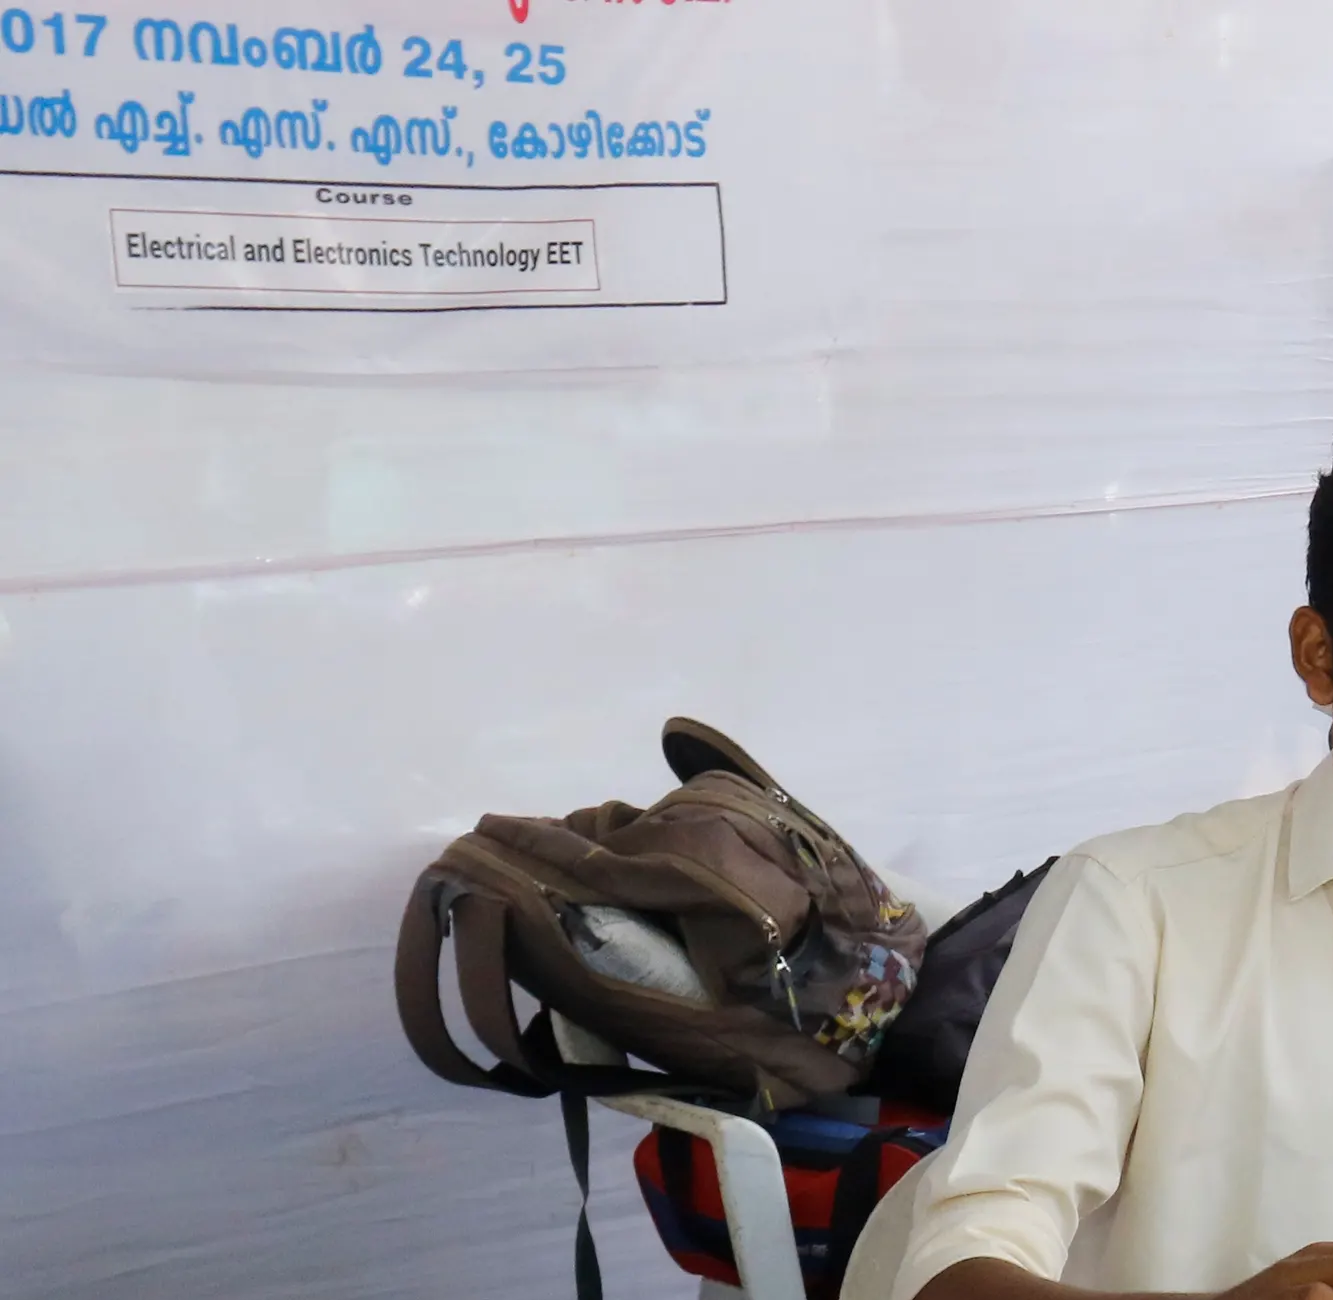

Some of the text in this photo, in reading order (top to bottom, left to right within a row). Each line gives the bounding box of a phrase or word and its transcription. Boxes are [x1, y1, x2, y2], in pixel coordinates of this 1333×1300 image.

[133, 17, 382, 76] നവംബർ
[401, 36, 485, 89] 24,
[504, 42, 566, 85] 25
[488, 109, 712, 159] കോഴിക്കോട്
[316, 187, 413, 206] Course
[126, 233, 583, 272] Electrical and Electronics Technology EET
